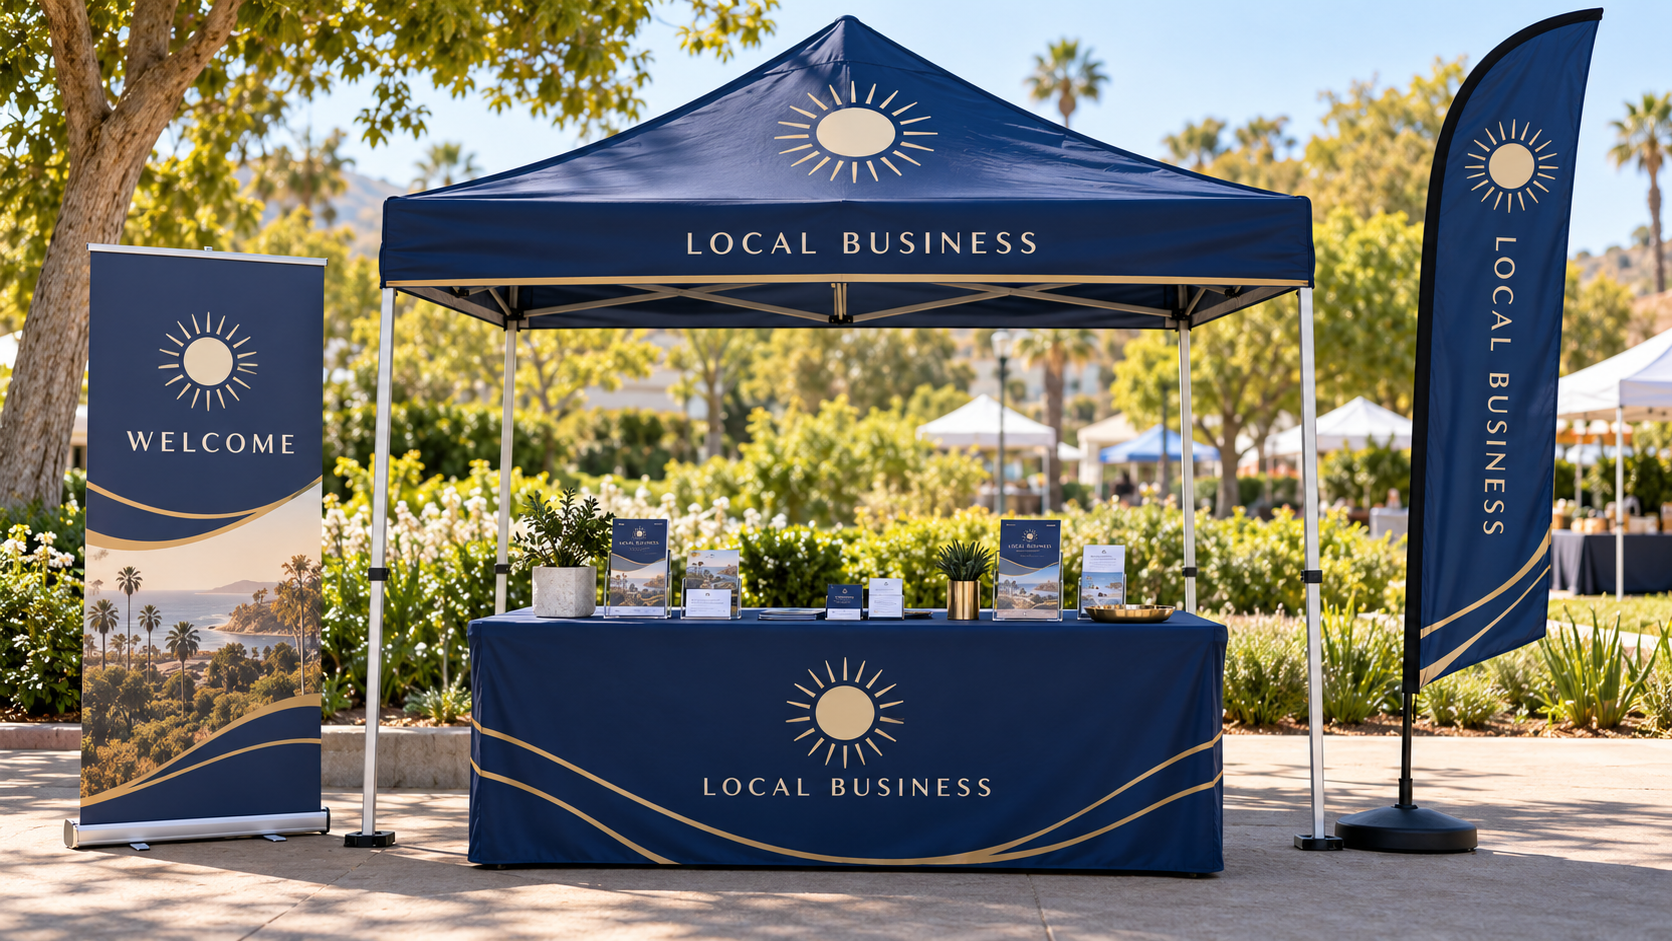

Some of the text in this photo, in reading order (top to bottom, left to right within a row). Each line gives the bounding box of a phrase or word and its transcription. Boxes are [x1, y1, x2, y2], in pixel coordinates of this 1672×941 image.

[688, 231, 1037, 255] LOCAL BUSINESS
[1483, 237, 1516, 535] LOCAL BUSINESS
[127, 431, 295, 454] WELCOME
[703, 777, 992, 797] LOCAL BUSINESS
